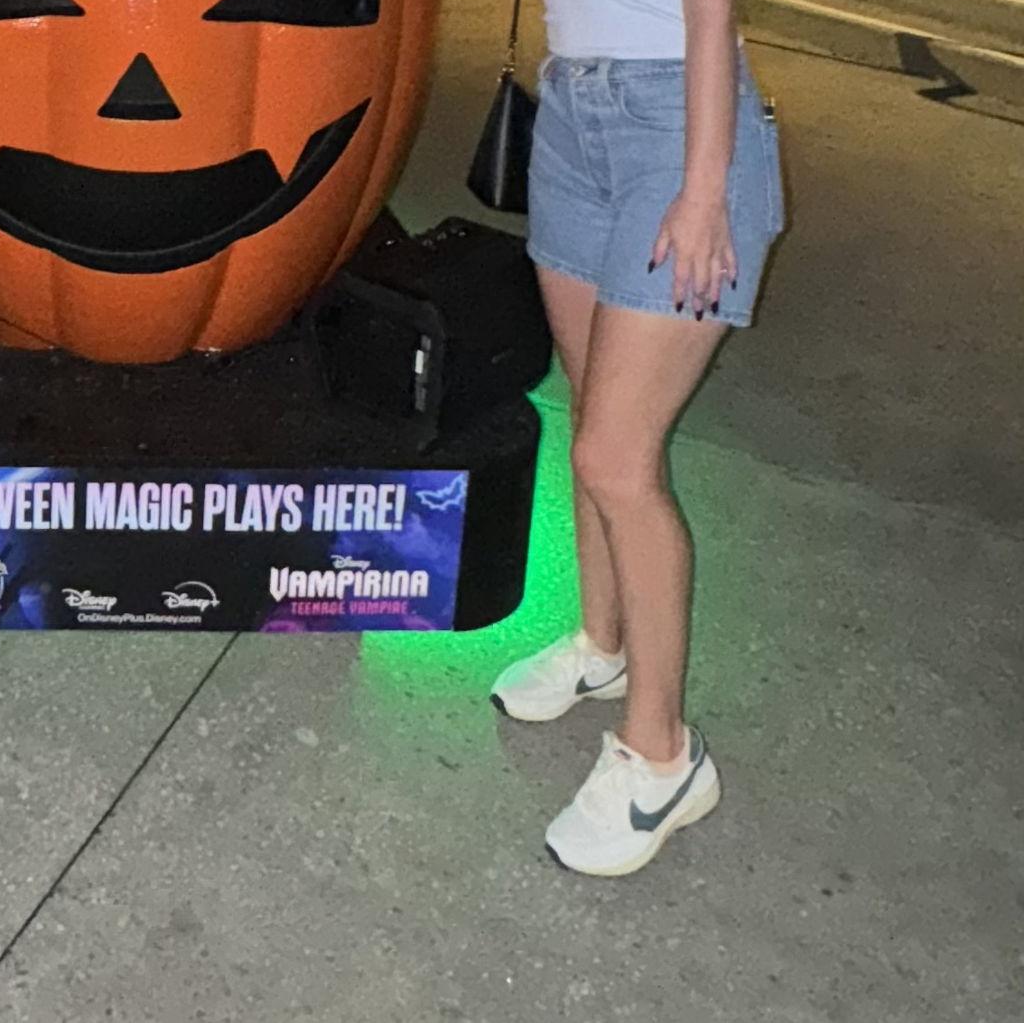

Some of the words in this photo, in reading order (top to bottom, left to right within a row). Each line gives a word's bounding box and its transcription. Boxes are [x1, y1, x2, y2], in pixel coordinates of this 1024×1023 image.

[85, 482, 193, 531] MAGIC
[203, 483, 304, 532] PLAYS
[312, 484, 407, 531] HERE!
[331, 554, 371, 571] Disney
[62, 588, 117, 611] Disney
[291, 601, 346, 615] TEENAGE
[349, 601, 408, 615] VAMPIRE
